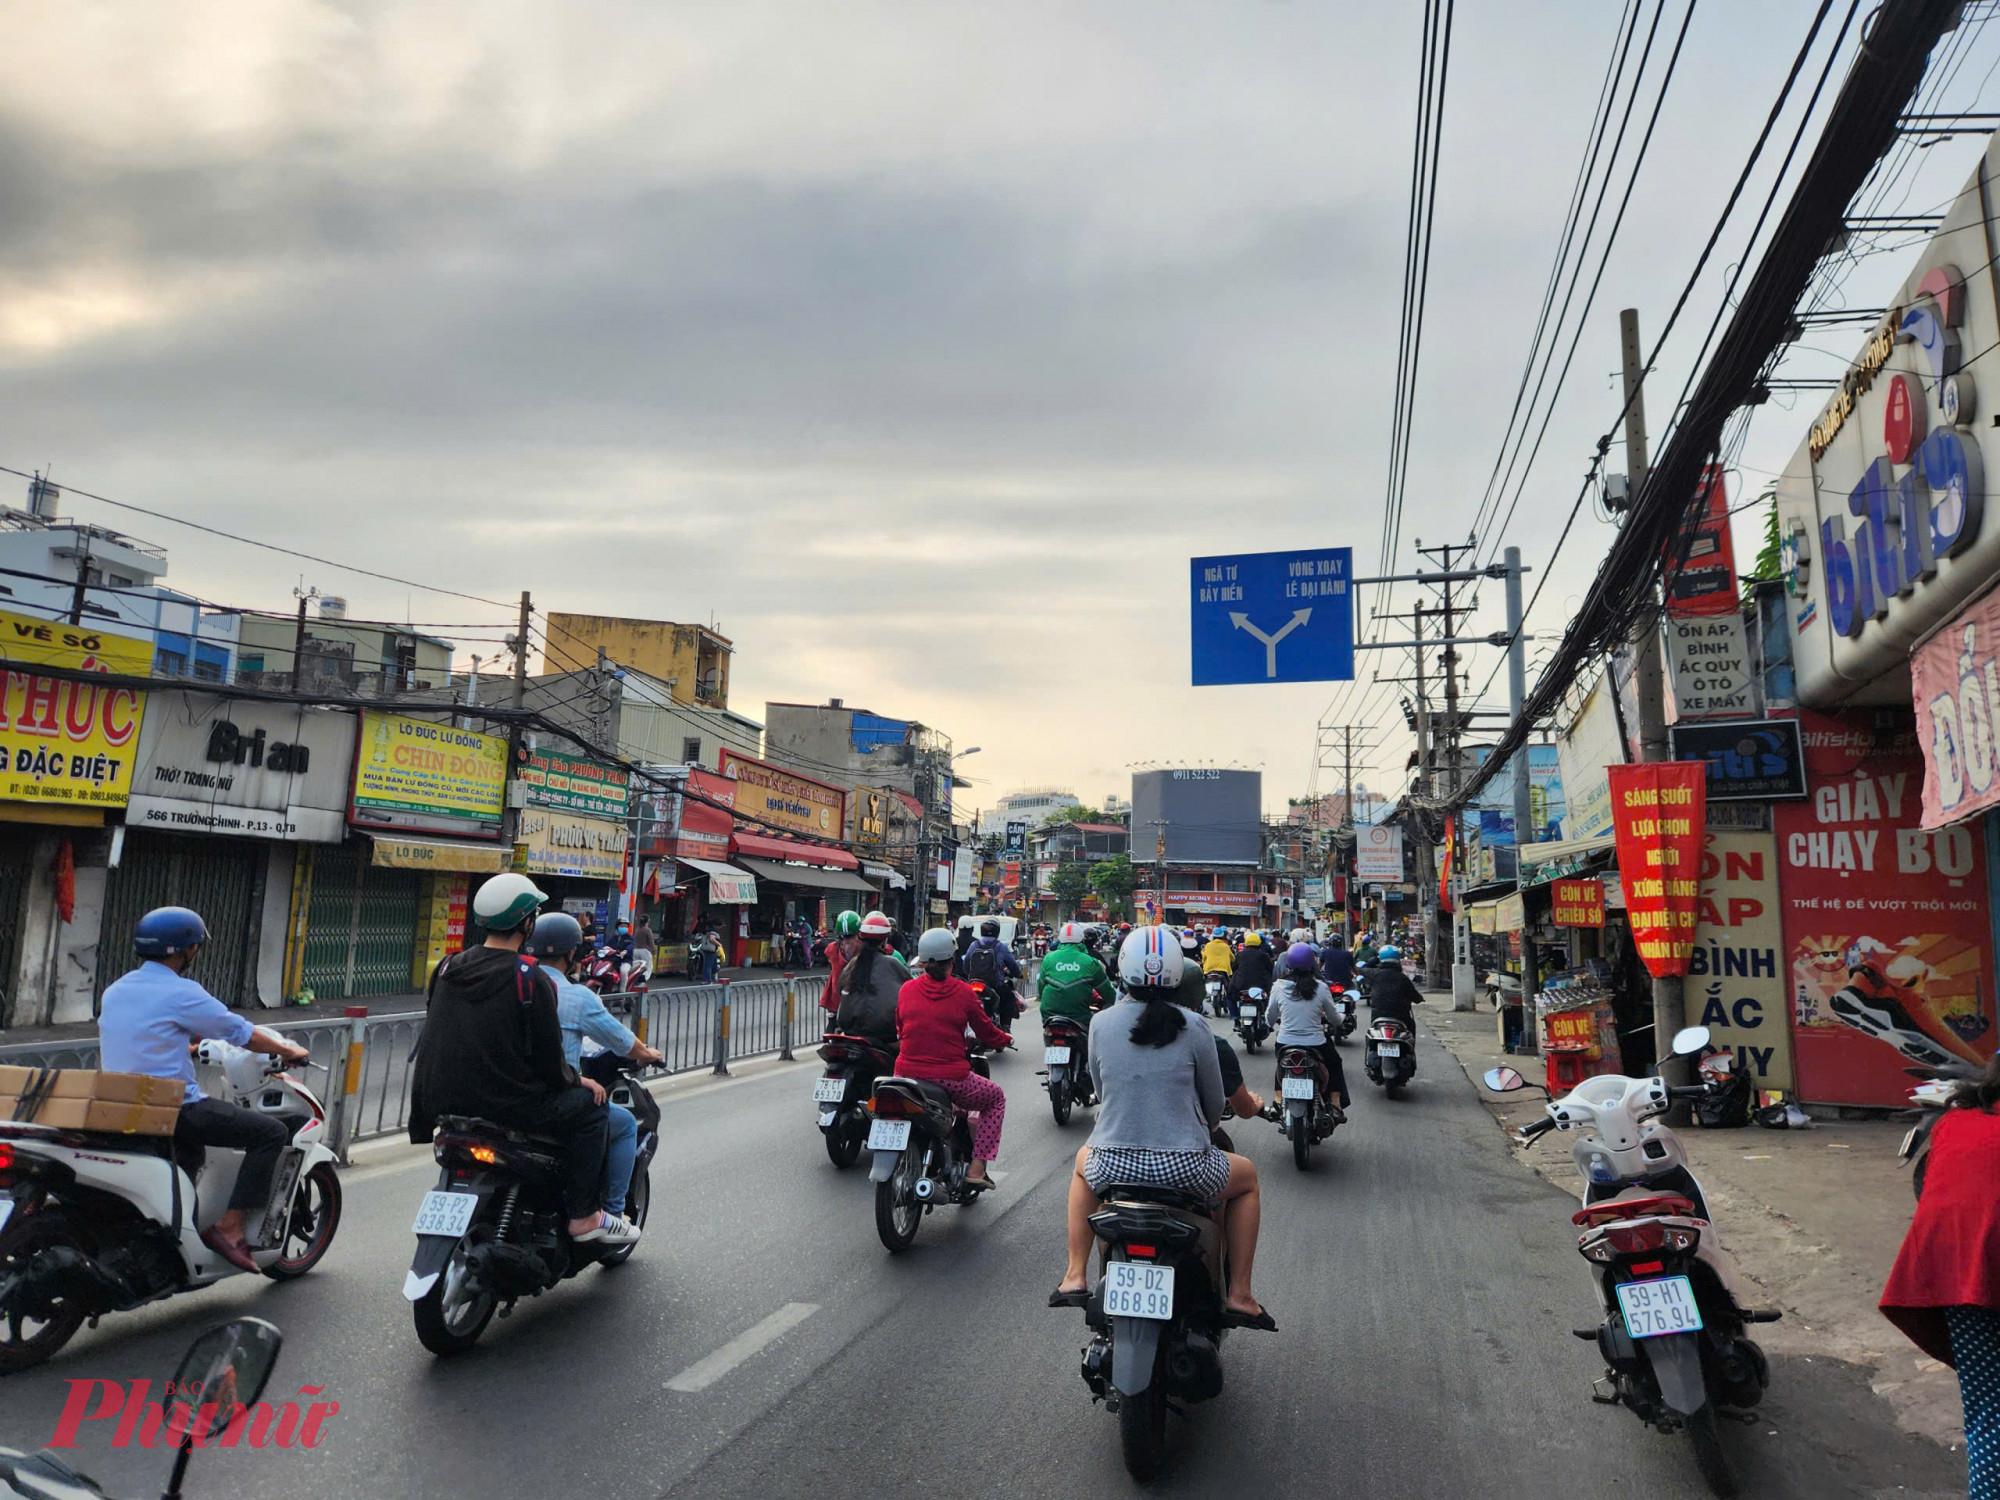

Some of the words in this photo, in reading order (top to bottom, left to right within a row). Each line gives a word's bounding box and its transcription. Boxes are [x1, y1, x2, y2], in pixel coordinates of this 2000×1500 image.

[1204, 565, 1223, 583] NGÃ
[1226, 564, 1238, 581] TƯ
[1289, 560, 1314, 577] VÒNG
[1317, 559, 1343, 576] XOAY
[1200, 584, 1219, 602] BẢY
[1286, 580, 1297, 598] LÊ
[1300, 581, 1318, 599] ĐẠI
[1320, 578, 1346, 595] HÀNH
[62, 634, 101, 651] SỐ
[1687, 641, 1729, 656] BÌNH
[1705, 660, 1742, 673] QUY
[1693, 677, 1706, 690] Ô
[1708, 676, 1732, 690] TÔ
[1683, 697, 1705, 709] XE
[1708, 694, 1747, 708] MÁY
[206, 718, 311, 774] Brian
[16, 745, 65, 781] ĐẶC
[69, 753, 121, 787] BIỆT
[1173, 769, 1190, 780] 0911
[1191, 768, 1205, 780] 522
[1206, 768, 1220, 780] 522
[183, 771, 216, 788] TRANG
[217, 775, 236, 791] NỮ
[363, 773, 383, 781] MUA
[1624, 787, 1658, 807] SÁNG
[1660, 783, 1693, 805] SUỐT
[1815, 769, 1907, 824] GIÀY
[147, 809, 168, 822] 566
[247, 820, 268, 832] P.13
[1632, 818, 1656, 840] LỰA
[1657, 819, 1690, 839] CHỌN
[1646, 846, 1680, 866] NGƯỜI
[1788, 830, 1879, 878] CHẠY
[1560, 884, 1580, 902] CÒN
[1583, 884, 1596, 902] VÉ
[1632, 878, 1664, 898] XỨNG
[1666, 877, 1698, 897] ĐÁNG
[1588, 903, 1602, 924] SỐ
[1793, 896, 1820, 909] THẾ
[1823, 899, 1842, 911] HỆ
[1868, 899, 1908, 912] VƯỢT
[1911, 899, 1946, 912] TRỘI
[1949, 898, 1978, 911] MỚI
[1652, 907, 1677, 931] DIỆN
[1055, 961, 1080, 972] Grab
[1689, 938, 1777, 979] BÌNH
[1700, 982, 1764, 1029] ẮC
[1553, 1018, 1575, 1037] CÒN
[1576, 1016, 1590, 1035] VÉ
[429, 1195, 469, 1214] 59-P2
[416, 1213, 466, 1233] 938.34
[1116, 1266, 1164, 1291] 59-D2
[1109, 1290, 1169, 1316] 868.98
[1627, 1281, 1682, 1309] 59-H1
[1629, 1305, 1697, 1334] 576.94
